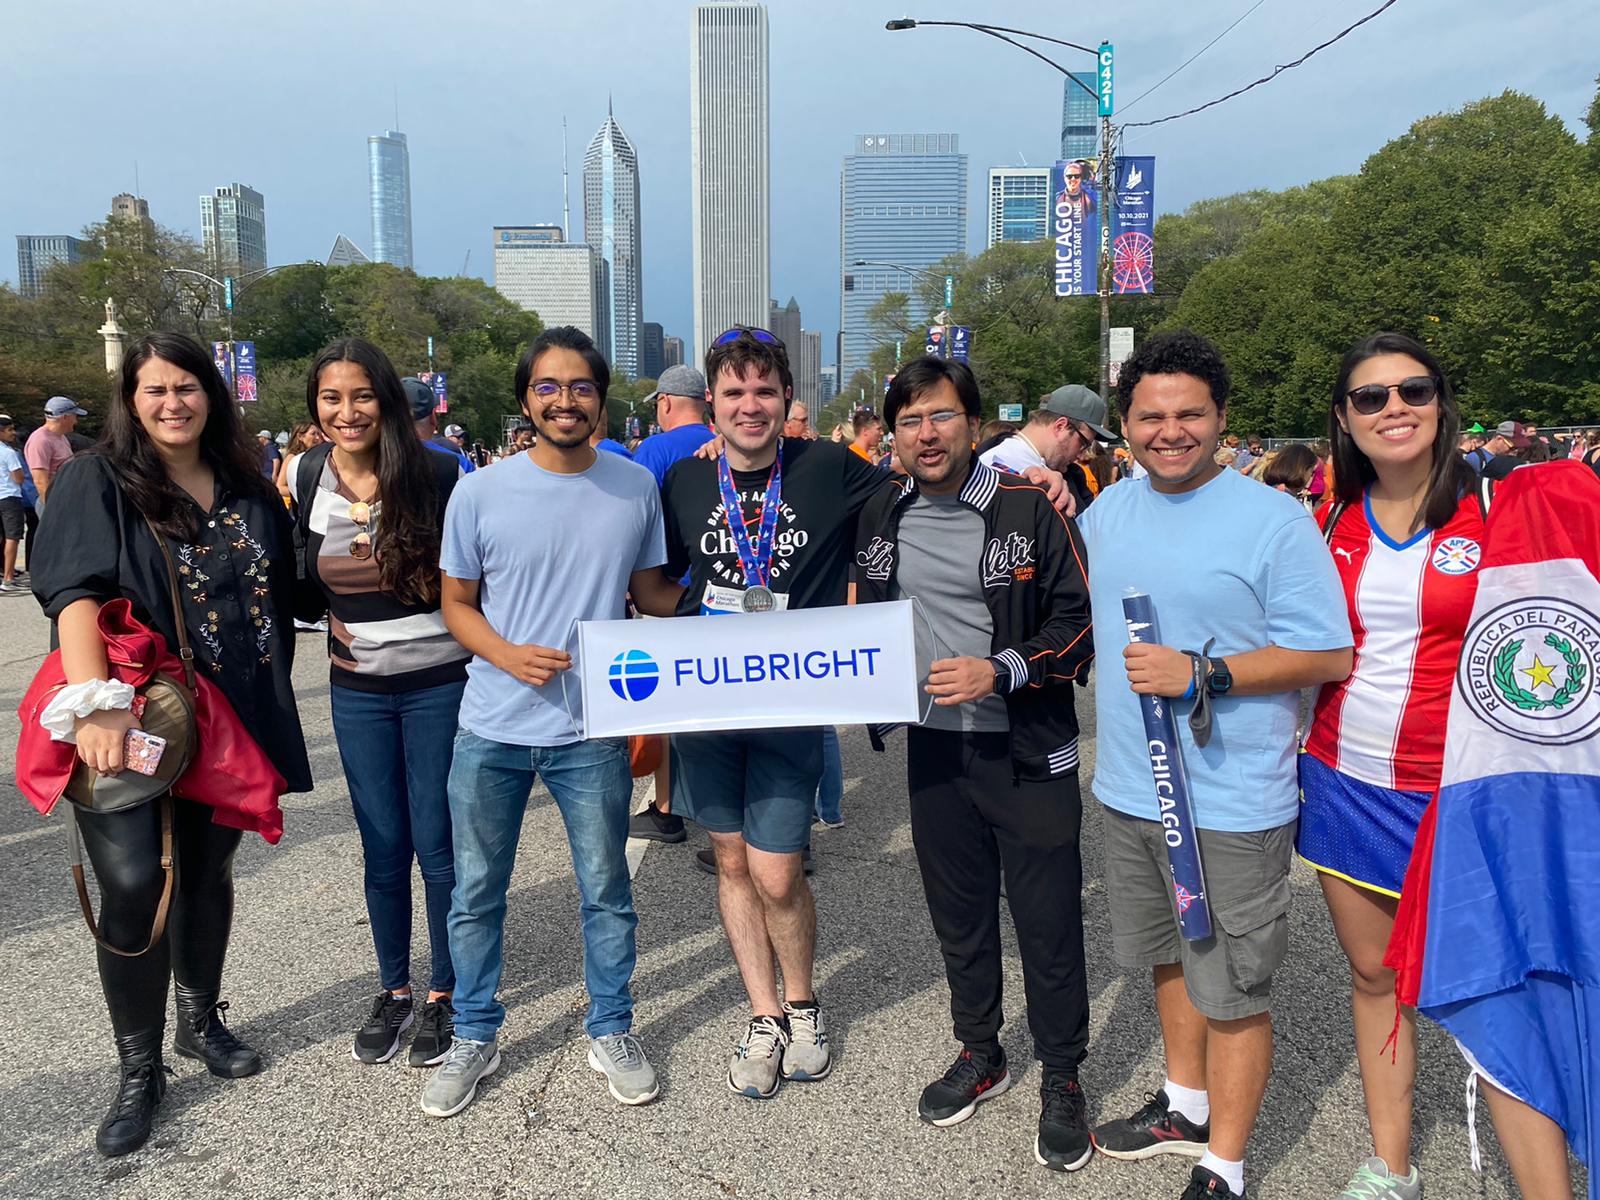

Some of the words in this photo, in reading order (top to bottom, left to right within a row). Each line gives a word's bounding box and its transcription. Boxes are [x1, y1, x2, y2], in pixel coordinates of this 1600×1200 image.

[1100, 51, 1113, 108] C421
[1073, 202, 1082, 224] LINE
[1055, 201, 1073, 297] CHICAGO
[1073, 226, 1082, 256] START
[1073, 257, 1082, 286] YOUR
[1073, 286, 1082, 295] IS
[707, 502, 725, 527] BAN
[674, 647, 881, 687] FULBRIGHT
[1471, 622, 1512, 712] REPUBLICA
[1513, 611, 1548, 627] DEL
[1148, 739, 1183, 848] CHICAGO
